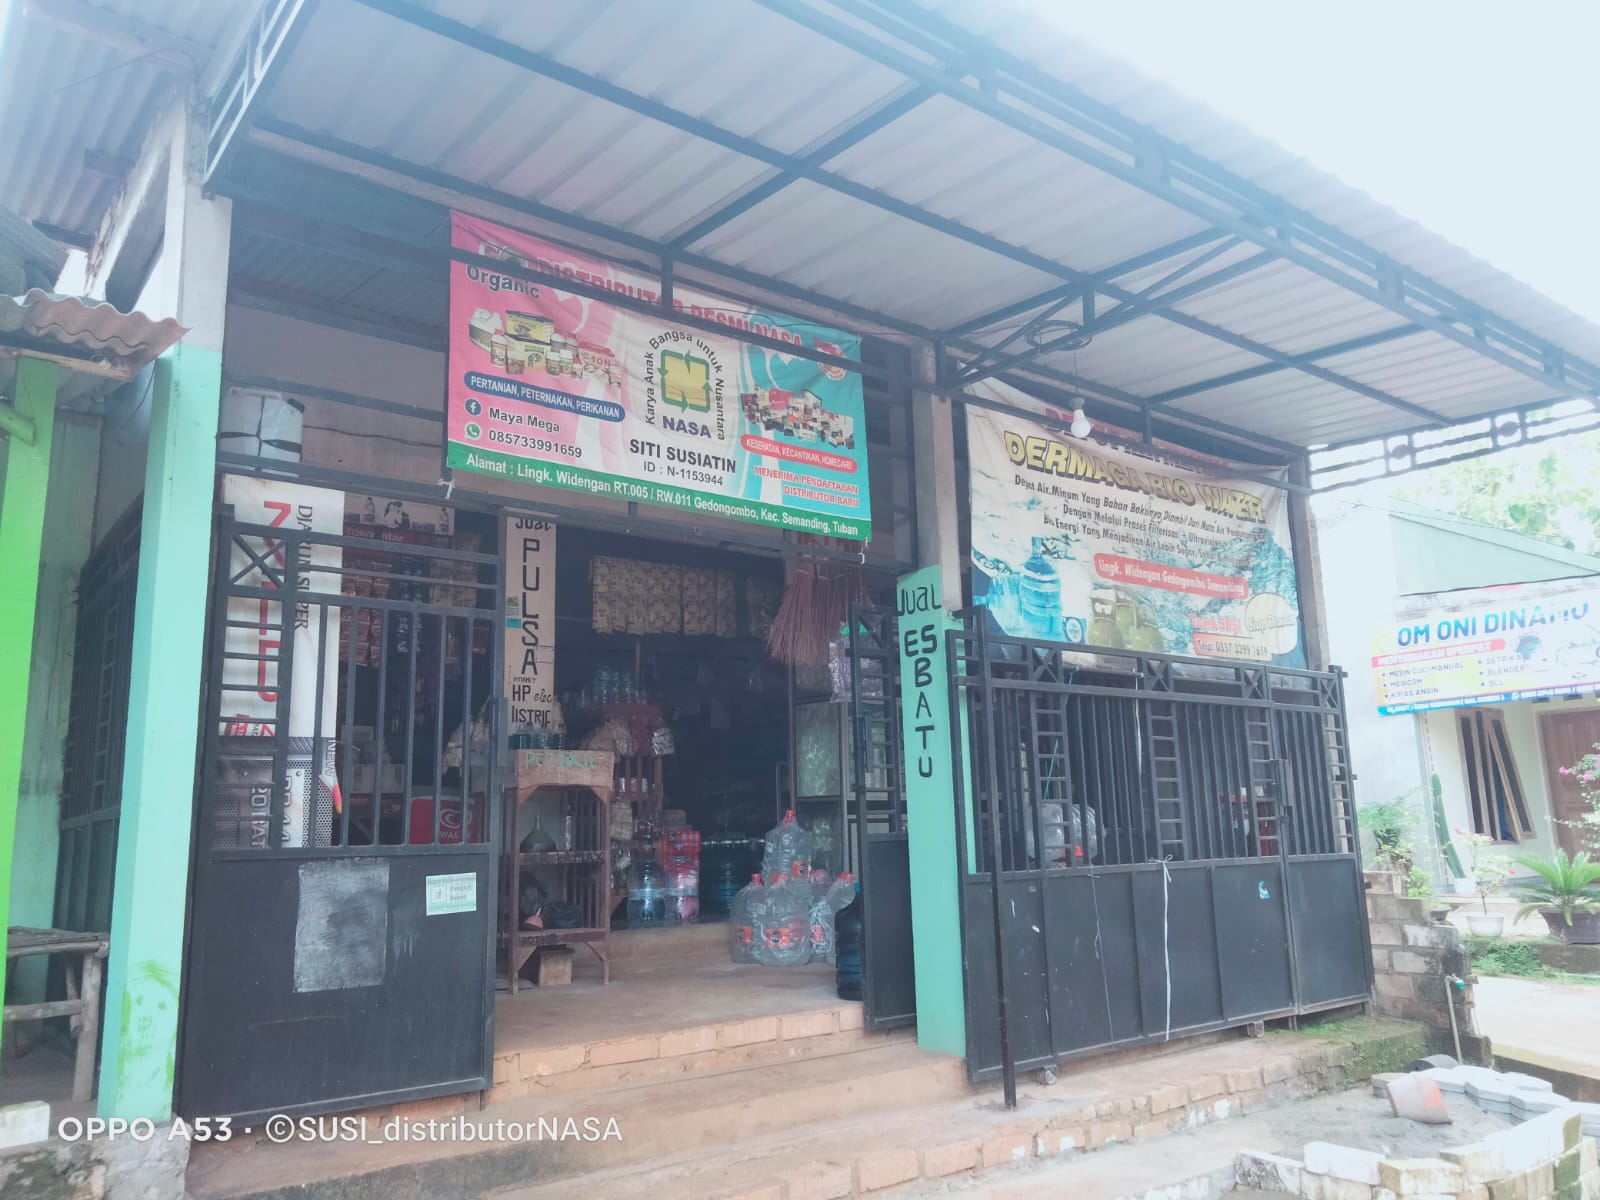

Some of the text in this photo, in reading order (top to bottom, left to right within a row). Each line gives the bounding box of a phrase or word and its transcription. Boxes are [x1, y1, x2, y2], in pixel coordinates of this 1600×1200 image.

[467, 265, 540, 298] Organic
[471, 375, 620, 418] PERTANIAN, PETERNAKAN, PERIKANAN
[644, 331, 725, 441] Karya Anak Bangsa untuk Nusantara
[489, 408, 560, 432] Maya Mega
[662, 415, 712, 439] NASA
[489, 430, 582, 458] 085733991659
[629, 439, 737, 473] SITI SUSIATIN
[667, 466, 723, 486] N-1153944
[754, 466, 799, 482] MENERIMA
[466, 453, 507, 474] Alamat
[517, 464, 552, 482] Lingk.
[556, 470, 611, 493] Widengan
[614, 481, 648, 498] RT.005
[657, 491, 691, 507] RW.011
[694, 497, 759, 520] Gedongombo,
[761, 508, 780, 523] Kec.
[782, 513, 831, 533] Semanding,
[833, 521, 858, 536] Tuban
[784, 486, 835, 504] DISTRIBUTOR
[1051, 485, 1079, 502] Minum
[1081, 492, 1100, 508] Yang
[1103, 497, 1128, 512] Bahan
[1063, 503, 1092, 519] Dengan
[1094, 511, 1122, 526] Melalui
[1124, 517, 1146, 531] Proses
[1056, 518, 1079, 534] Energi
[1082, 524, 1101, 539] Yang
[1103, 528, 1143, 545] Menjadikan
[521, 538, 540, 675] PULSA
[904, 624, 938, 657] ES
[1397, 623, 1430, 647] OM
[1437, 616, 1477, 641] ONI
[512, 684, 531, 702] HP
[914, 657, 936, 778] BATU
